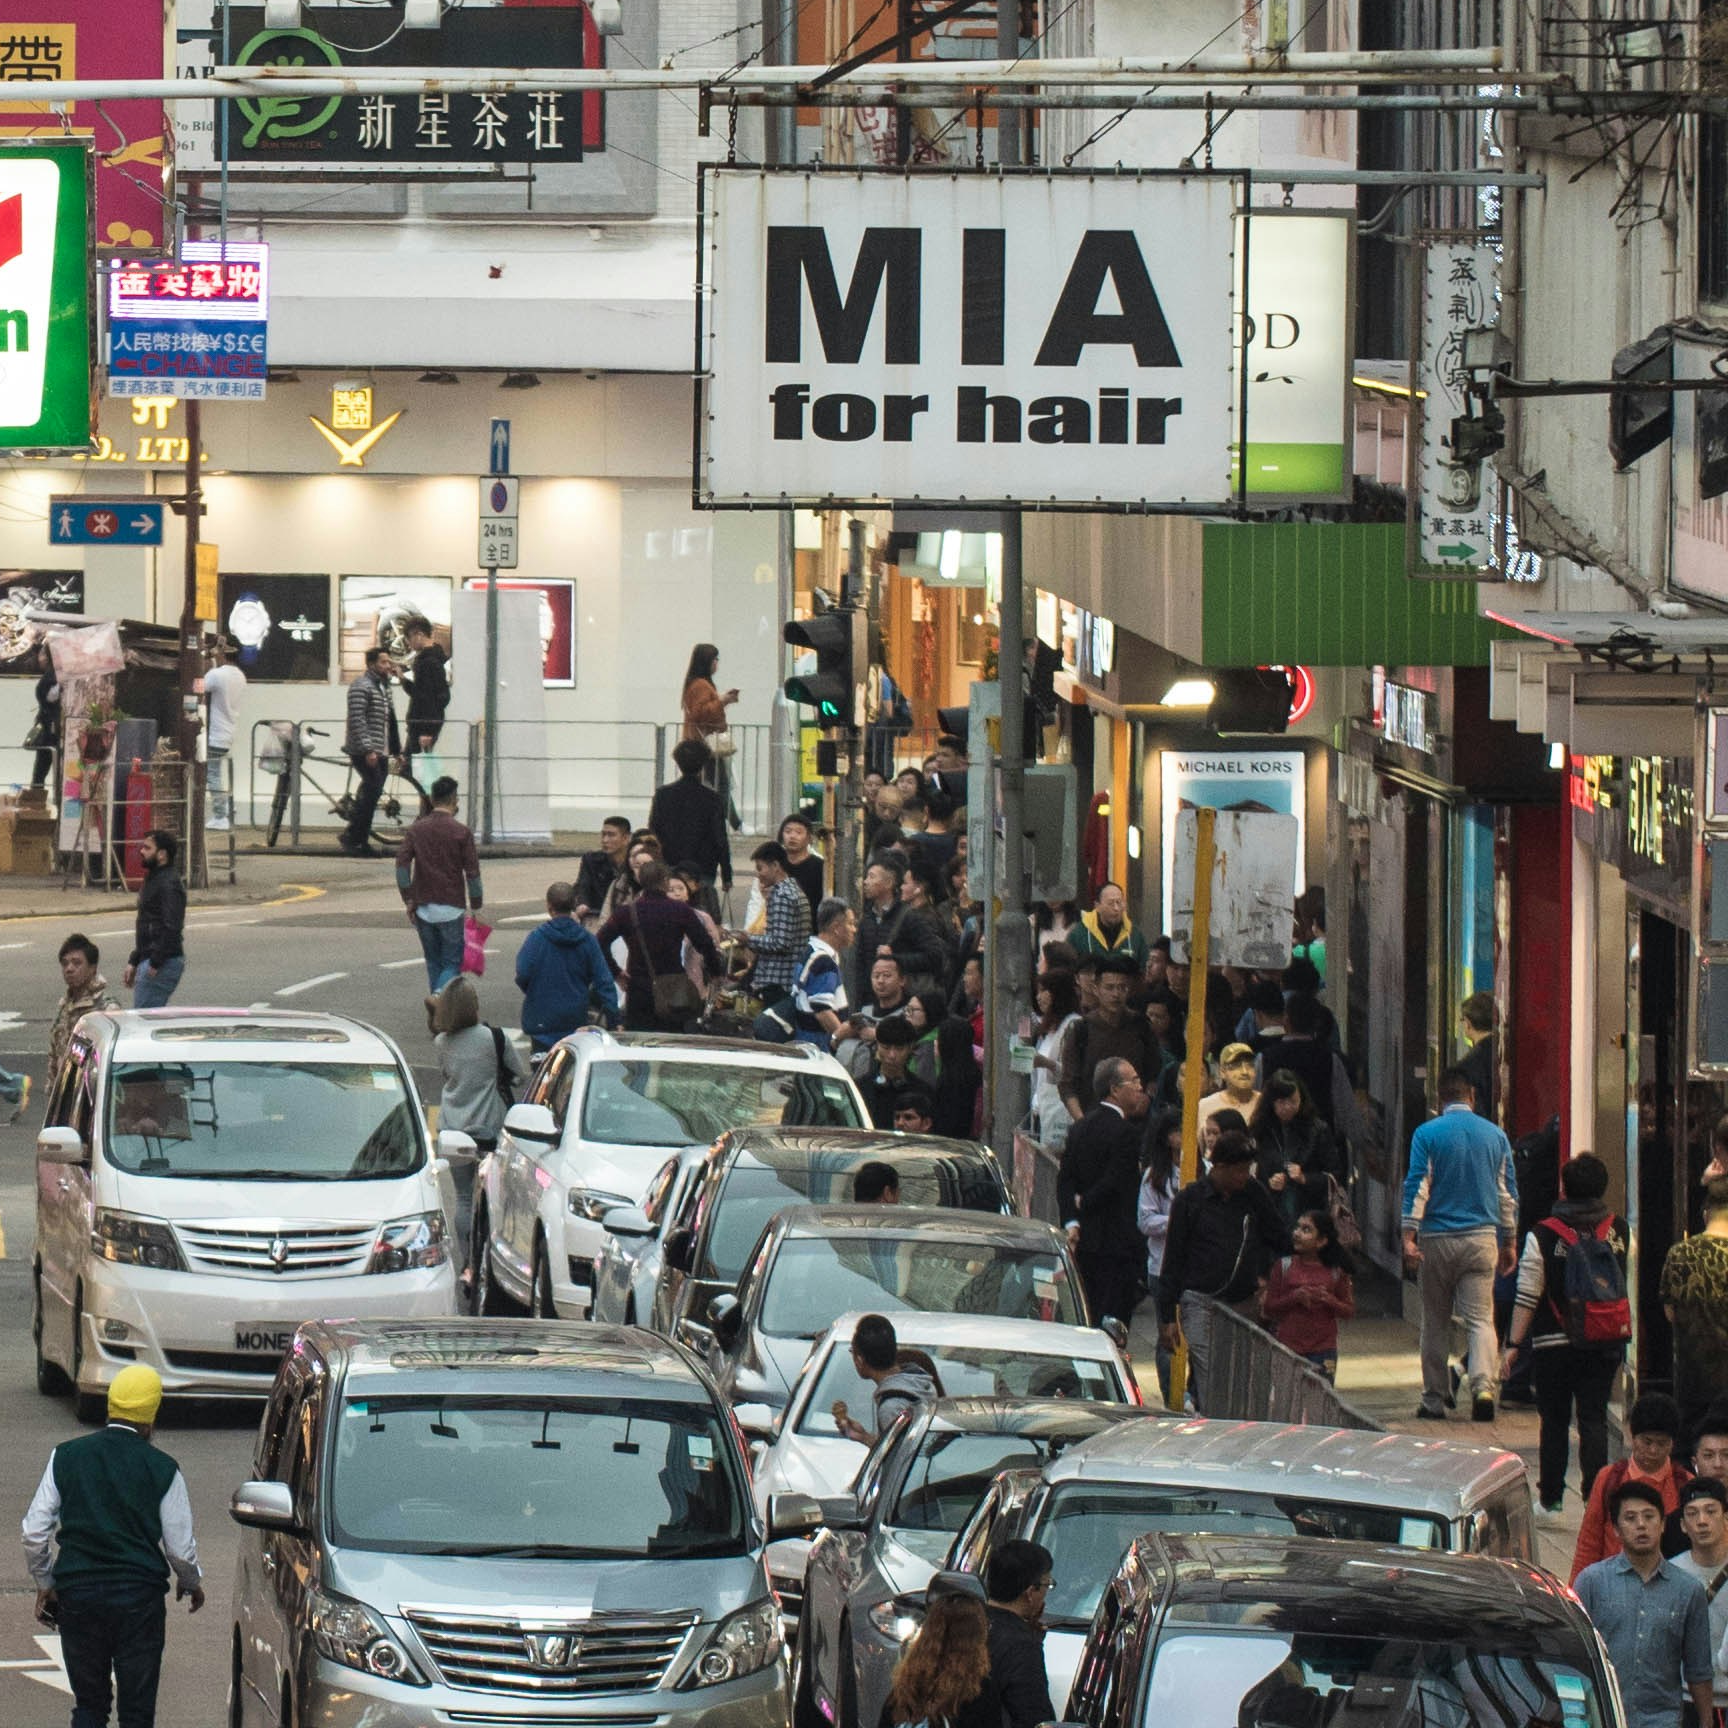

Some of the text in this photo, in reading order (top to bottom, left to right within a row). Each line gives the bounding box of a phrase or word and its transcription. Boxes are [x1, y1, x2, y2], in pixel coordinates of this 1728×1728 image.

[765, 225, 1183, 368] MIA
[141, 353, 265, 377] CHANGE
[768, 384, 1183, 445] for hair
[483, 523, 513, 537] 24 hrs
[485, 542, 510, 561] 全日
[1177, 760, 1293, 775] MICHAEL KORS
[236, 1332, 294, 1351] MONE
